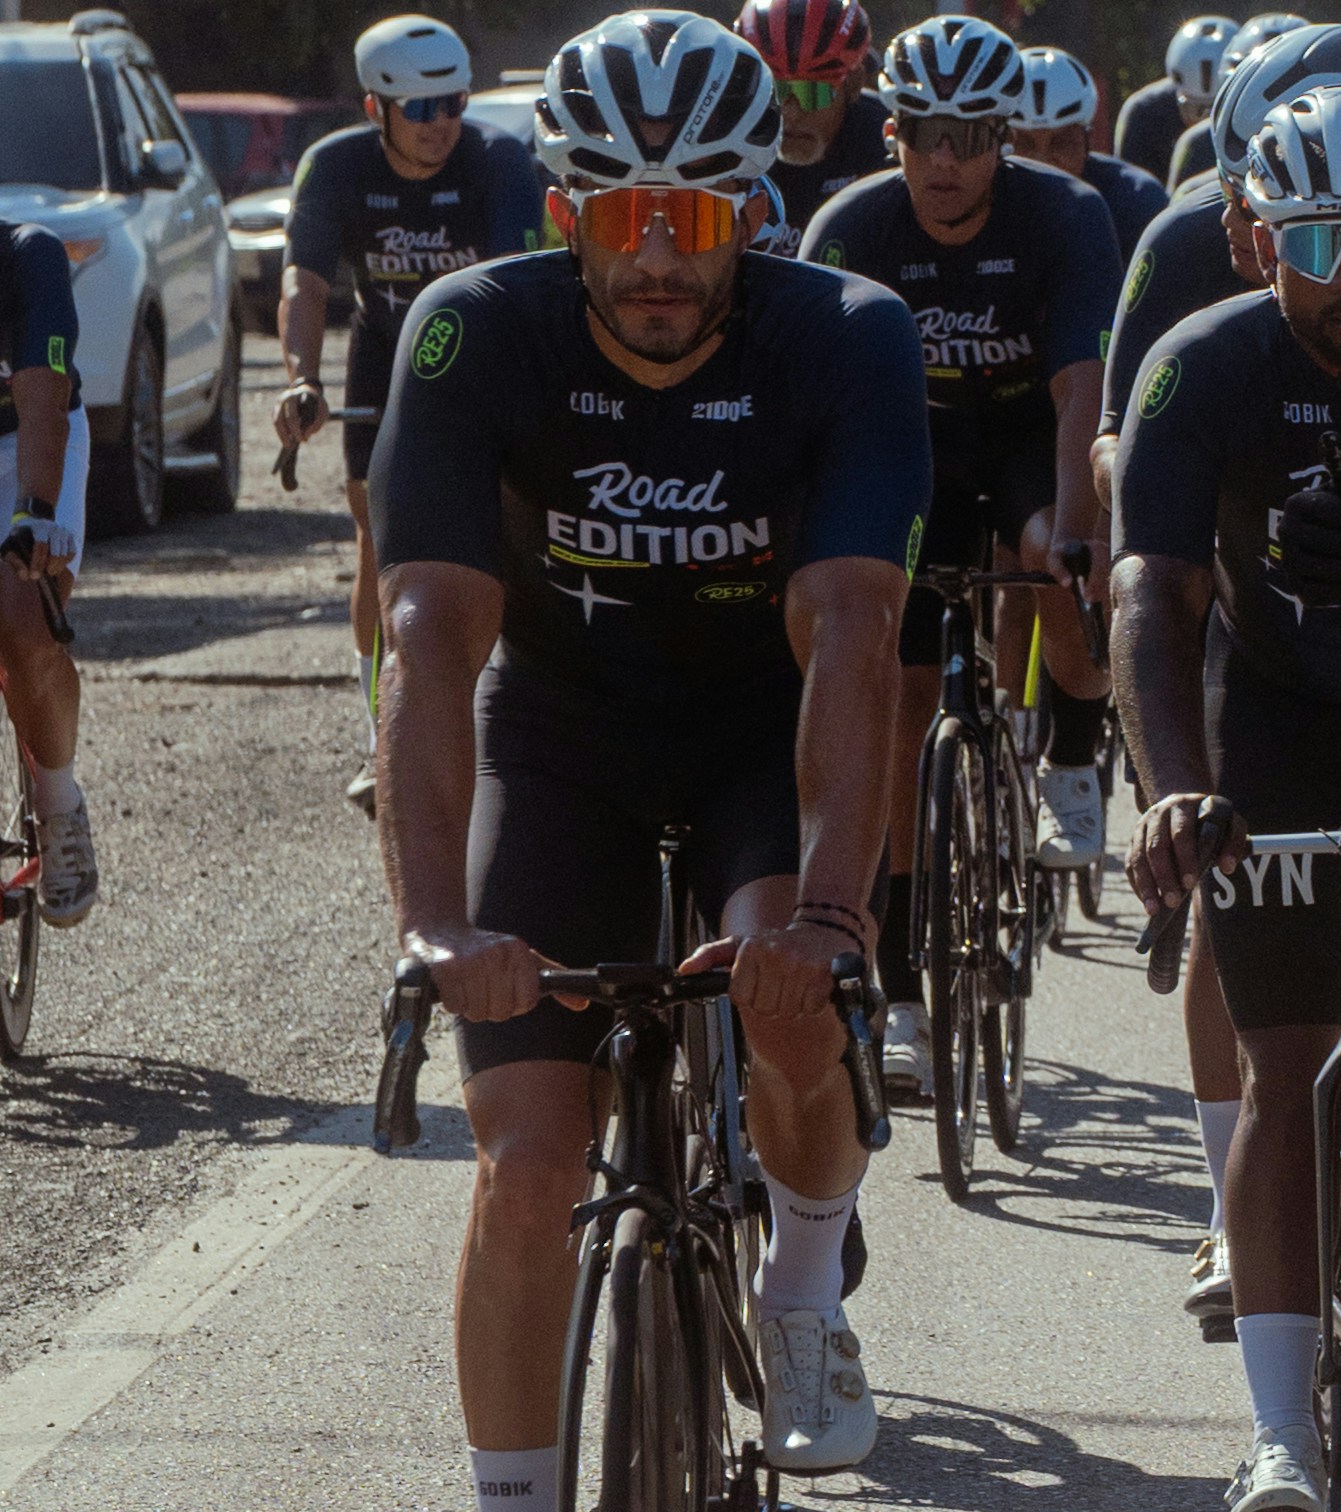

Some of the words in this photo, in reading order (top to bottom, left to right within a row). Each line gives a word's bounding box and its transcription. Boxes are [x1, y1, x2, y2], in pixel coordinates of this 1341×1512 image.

[375, 224, 452, 254] Road
[365, 246, 478, 275] EDITION
[912, 305, 1000, 339] Road
[417, 317, 454, 368] RE25
[922, 333, 1034, 367] DITION
[572, 461, 729, 519] Road
[546, 509, 770, 566] EDITION
[702, 583, 757, 601] RE25
[1211, 852, 1315, 910] SYN
[479, 1480, 532, 1497] GOBIK
